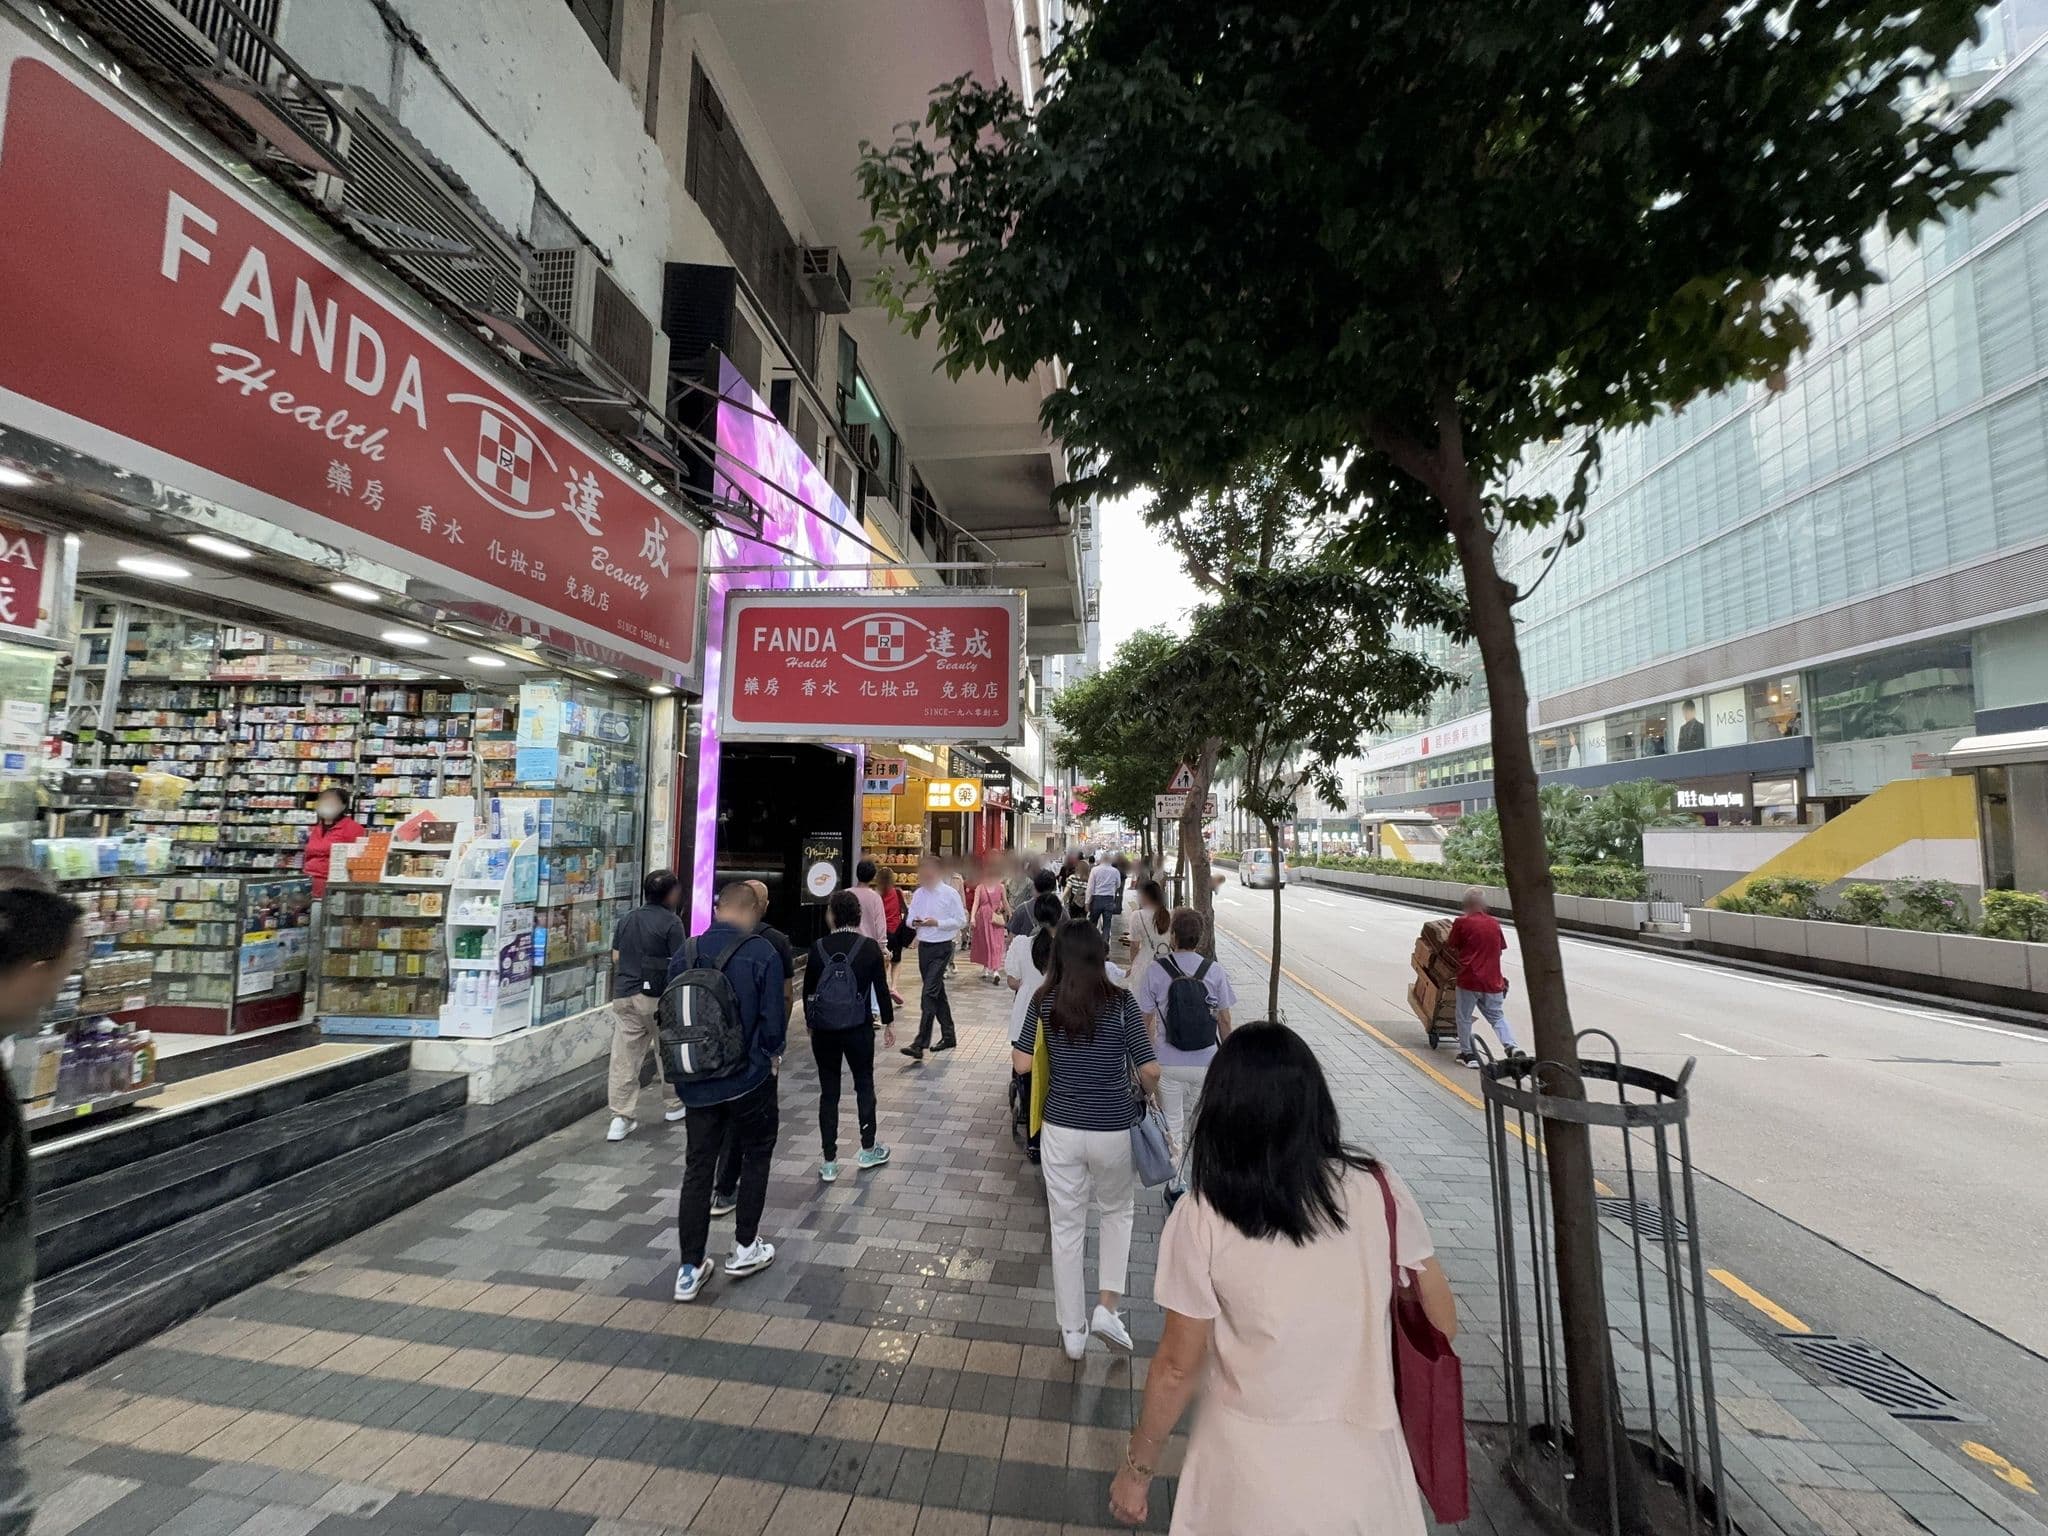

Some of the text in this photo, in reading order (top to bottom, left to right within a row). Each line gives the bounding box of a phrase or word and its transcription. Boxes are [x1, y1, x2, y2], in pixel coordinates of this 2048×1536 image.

[161, 189, 427, 431] FANDA
[210, 342, 389, 461] Health
[562, 465, 670, 578] 達成
[326, 460, 610, 612] 藥房 香水 化妝品 免稅店
[590, 546, 649, 600] Beauty
[617, 619, 637, 635] SINCE
[640, 629, 657, 644] 1980
[753, 626, 837, 653] FANDA
[925, 626, 992, 660] 達成
[785, 656, 829, 669] Health
[936, 658, 979, 672] Beauty
[743, 676, 999, 700] 藥房 香水 化妝品 免稅店
[1716, 709, 1745, 727] M&S
[1588, 736, 1607, 748] M&S
